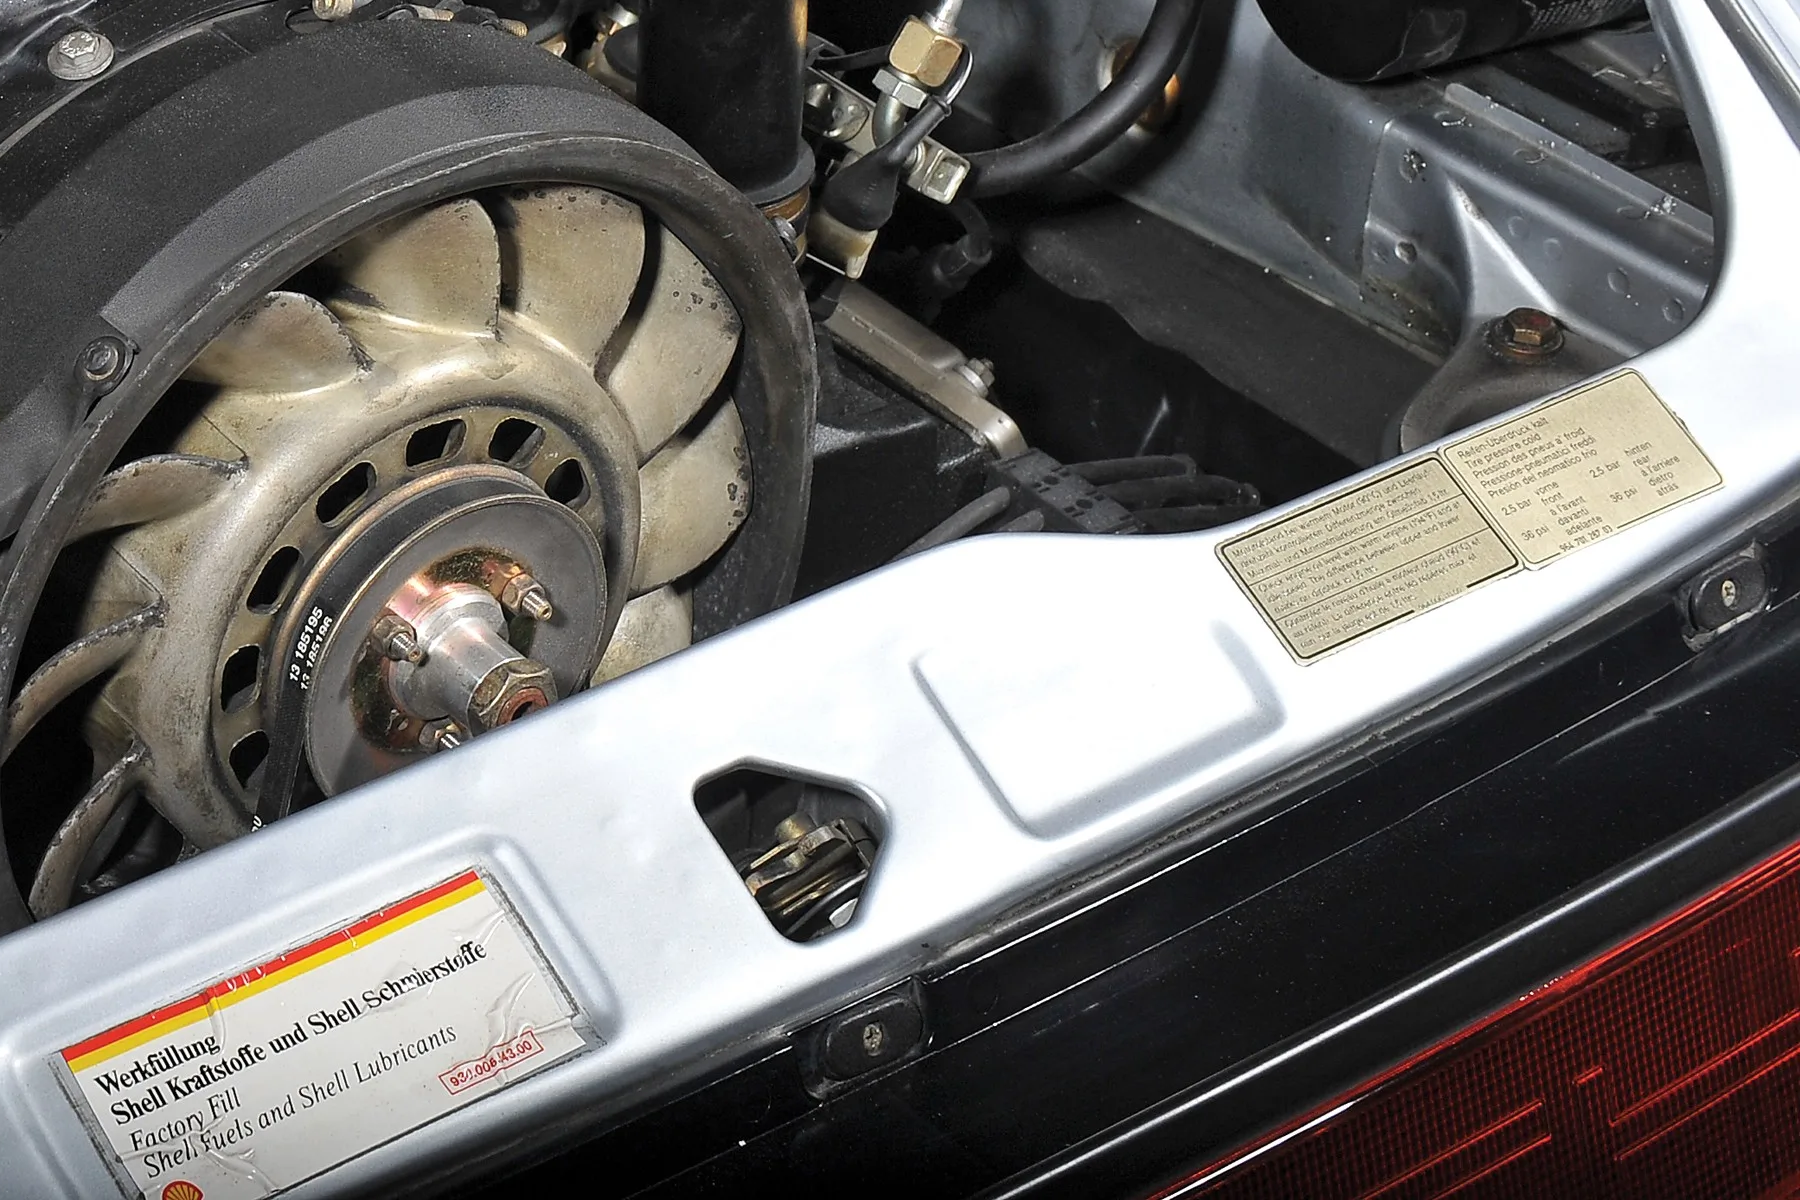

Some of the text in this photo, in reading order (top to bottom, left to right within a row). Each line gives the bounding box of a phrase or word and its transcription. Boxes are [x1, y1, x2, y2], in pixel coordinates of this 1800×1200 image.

[1465, 432, 1541, 468] Tire pressure cold
[1472, 459, 1510, 478] Pression
[1510, 452, 1527, 463] des
[1527, 441, 1554, 456] pneus
[1563, 426, 1585, 440] froid
[1480, 435, 1596, 487] Pressione-pneumatici freddi
[1604, 460, 1620, 471] bar
[1623, 441, 1651, 456] hinten
[1632, 455, 1649, 466] rear
[1522, 473, 1537, 483] del
[1537, 455, 1581, 477] neomatico
[1515, 498, 1531, 509] bar
[1534, 481, 1559, 495] vorne
[1540, 491, 1563, 505] front
[1609, 471, 1673, 502] 36 psi dietro
[1521, 508, 1589, 540] 36 psi davanti
[1565, 516, 1602, 535] adelante
[289, 606, 323, 681] 13 185195
[111, 941, 484, 1124] Shell Kraftstoffe und Shell Schmierstoffe
[95, 1037, 219, 1093] Werkfüllung
[143, 1027, 455, 1177] Shell Fuels and Shell Lubricants
[130, 1087, 240, 1156] Factory Fill
